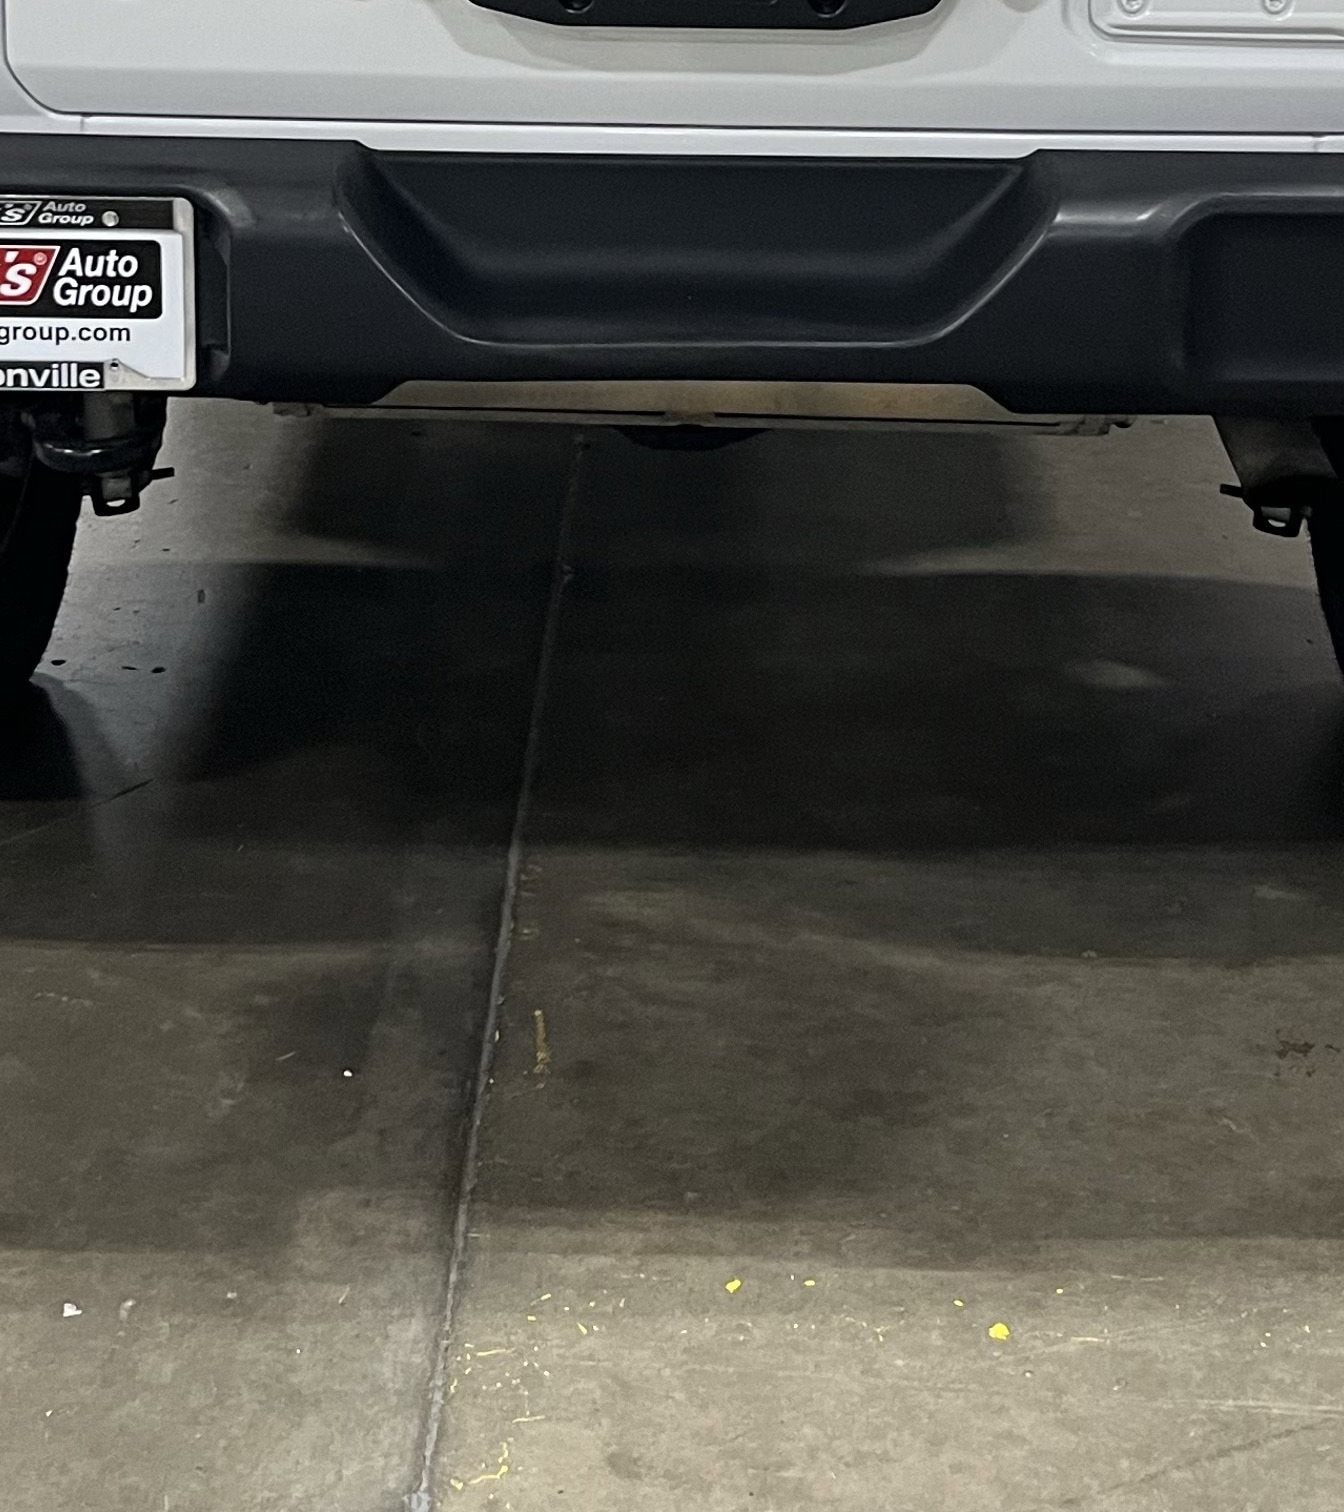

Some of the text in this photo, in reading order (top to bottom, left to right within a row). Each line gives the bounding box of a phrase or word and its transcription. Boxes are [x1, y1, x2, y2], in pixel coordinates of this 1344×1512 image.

[42, 201, 86, 213] Auto
[38, 212, 95, 227] Group
[58, 248, 139, 278] Auto
[53, 277, 154, 313] Group
